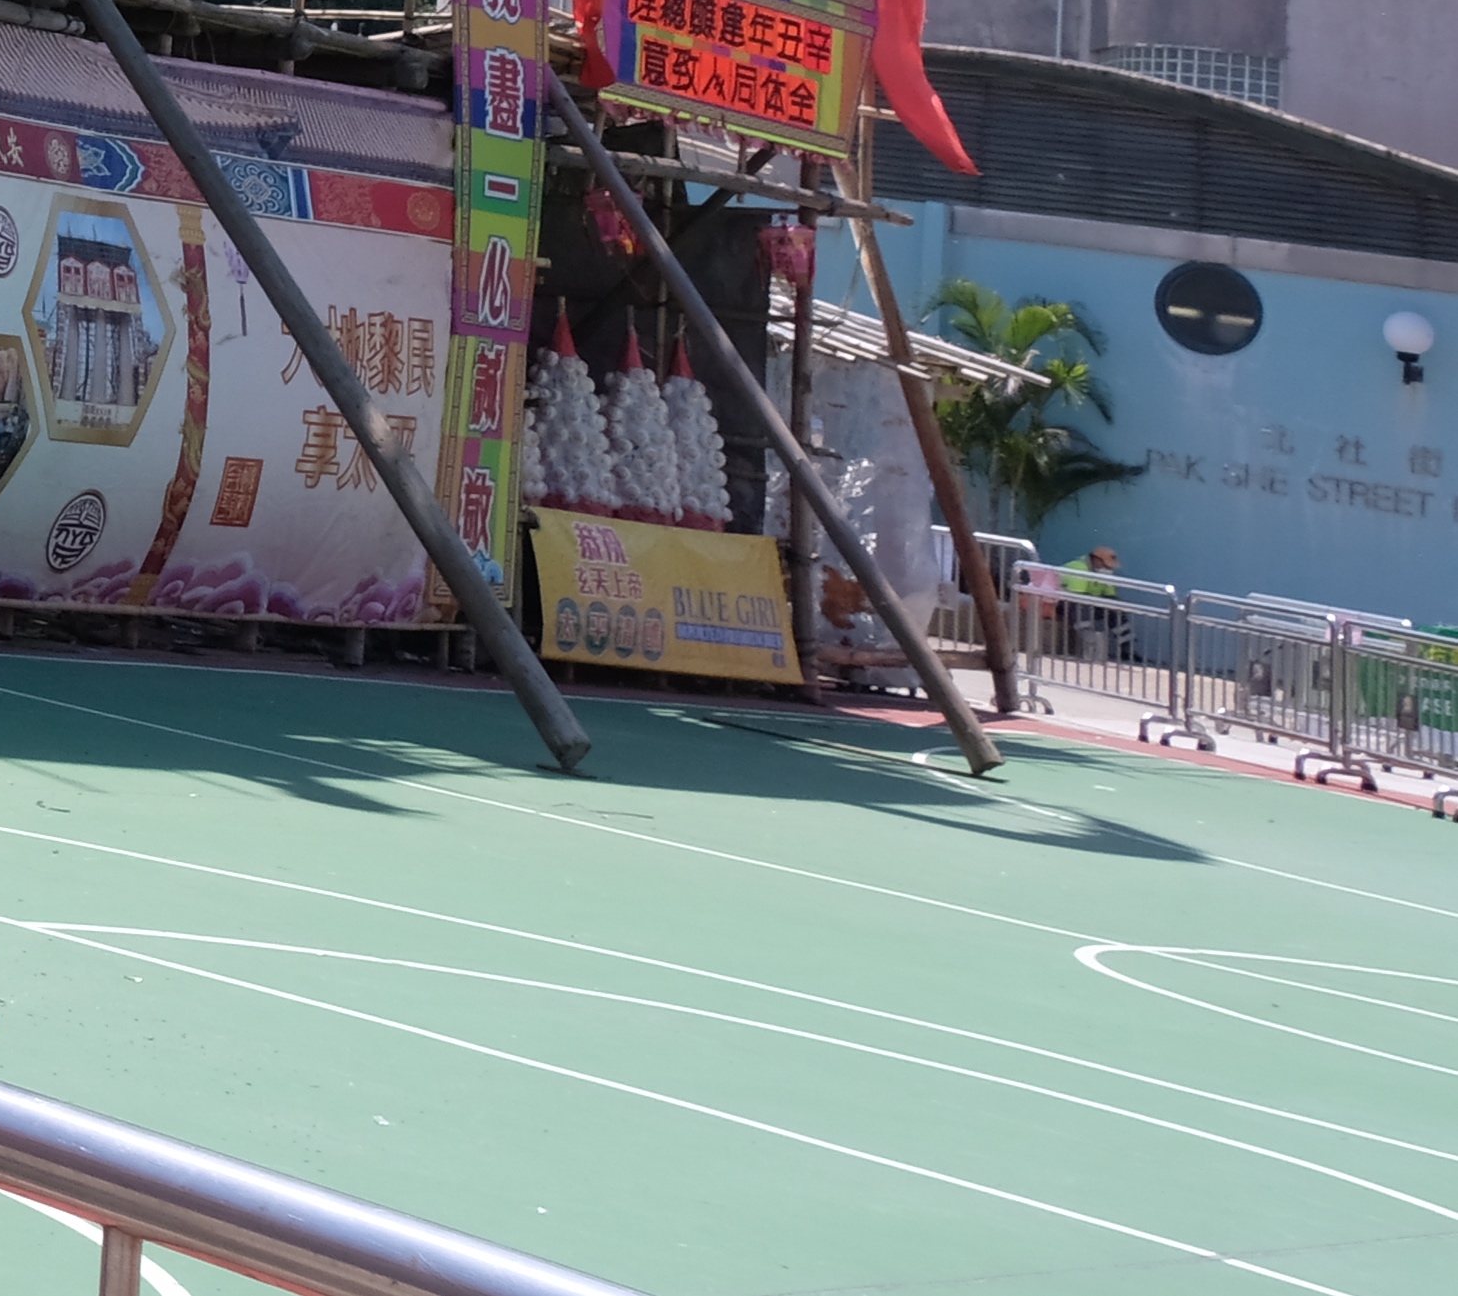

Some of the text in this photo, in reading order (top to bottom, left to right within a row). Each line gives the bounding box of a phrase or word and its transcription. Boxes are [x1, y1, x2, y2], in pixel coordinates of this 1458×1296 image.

[1307, 475, 1435, 519] STREET
[672, 586, 782, 629] BLUE GIRL
